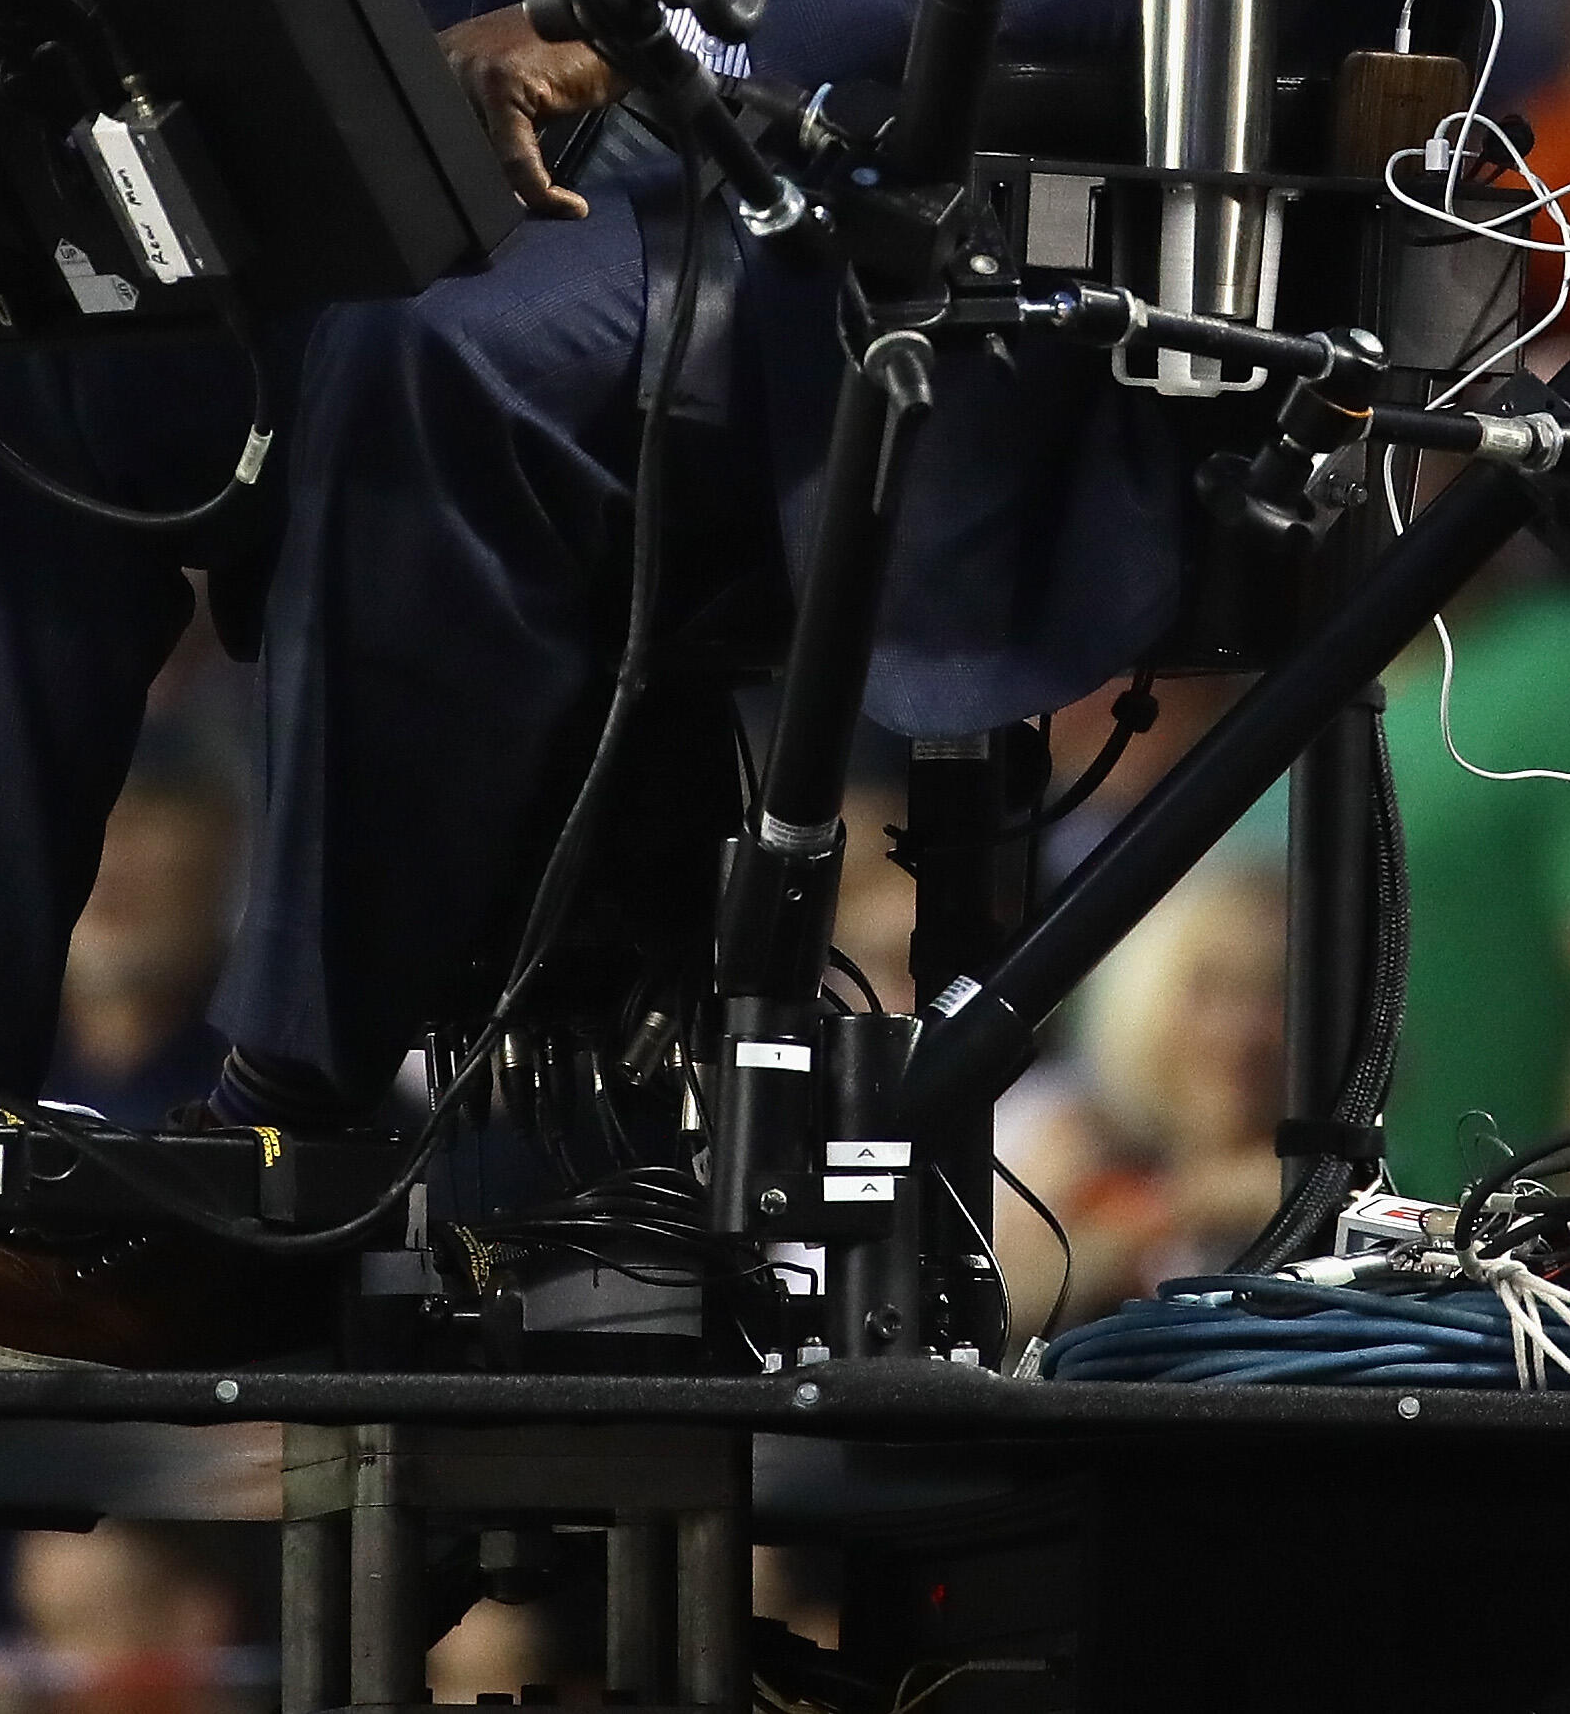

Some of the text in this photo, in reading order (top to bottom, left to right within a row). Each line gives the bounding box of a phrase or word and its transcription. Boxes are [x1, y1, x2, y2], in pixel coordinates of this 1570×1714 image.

[774, 1052, 781, 1061] 1
[857, 1148, 876, 1159] A
[861, 1183, 878, 1193] A
